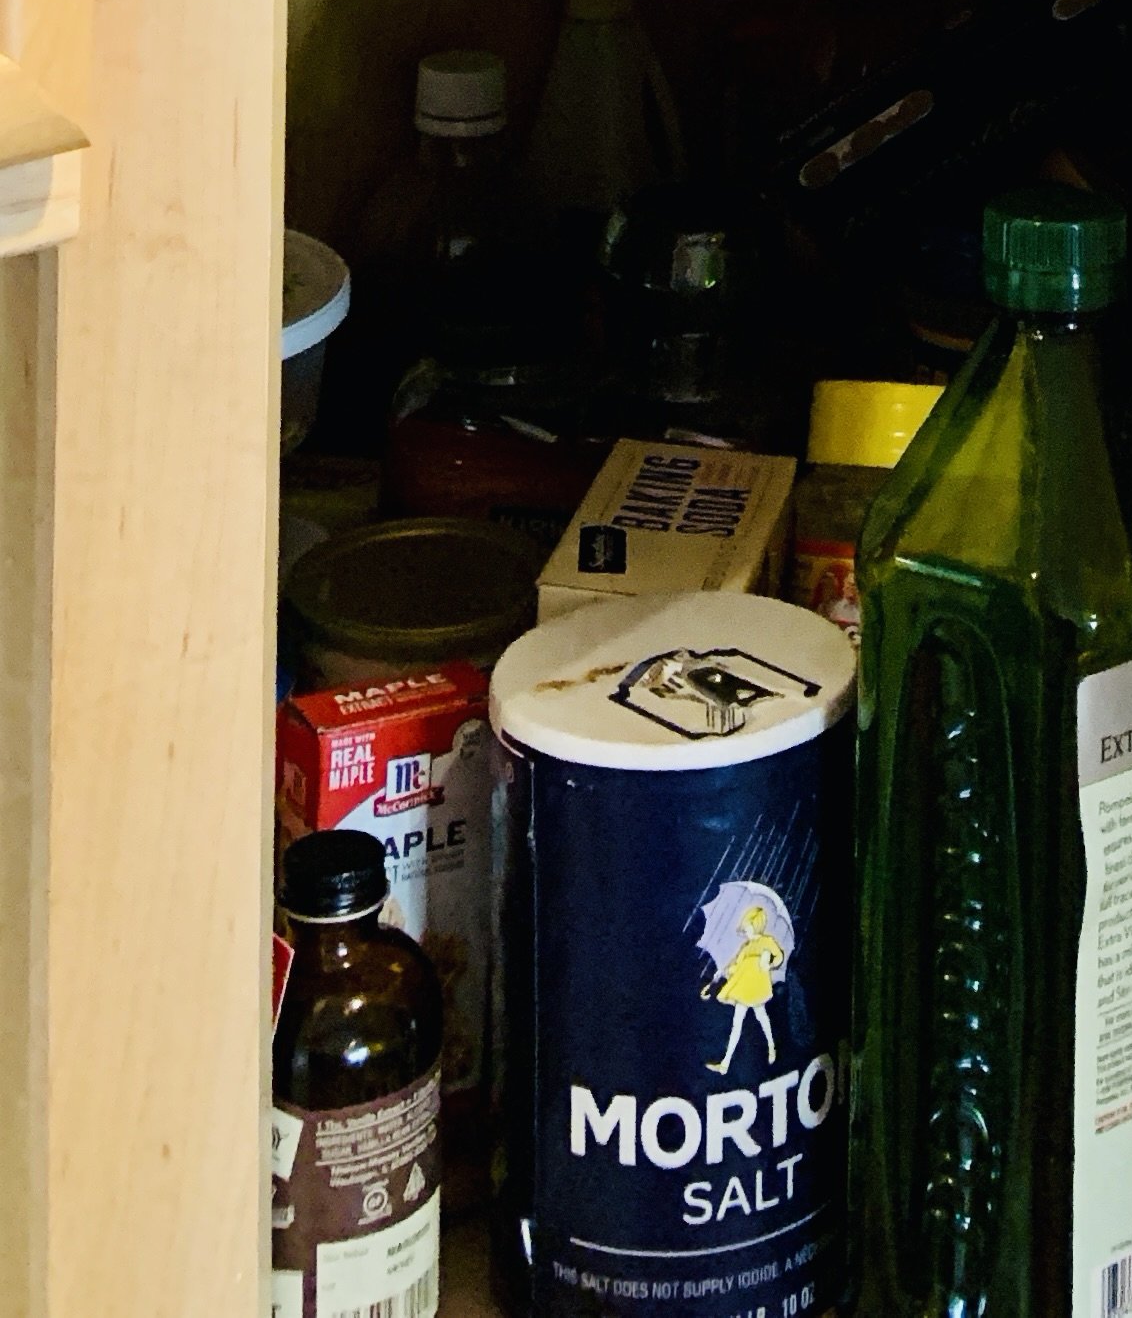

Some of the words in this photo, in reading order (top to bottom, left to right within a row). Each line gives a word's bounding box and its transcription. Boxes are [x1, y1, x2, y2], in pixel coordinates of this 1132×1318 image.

[612, 454, 701, 532] BAKING
[676, 488, 751, 538] SODA
[334, 672, 447, 706] MAPLE
[331, 743, 375, 768] REAL
[329, 761, 375, 792] MAPLE
[384, 819, 467, 861] APLE
[682, 1153, 804, 1225] SALT
[581, 1271, 610, 1294] SALT
[614, 1278, 648, 1299] DOES
[652, 1279, 680, 1300] NOT
[683, 1272, 733, 1299] SUPPLY
